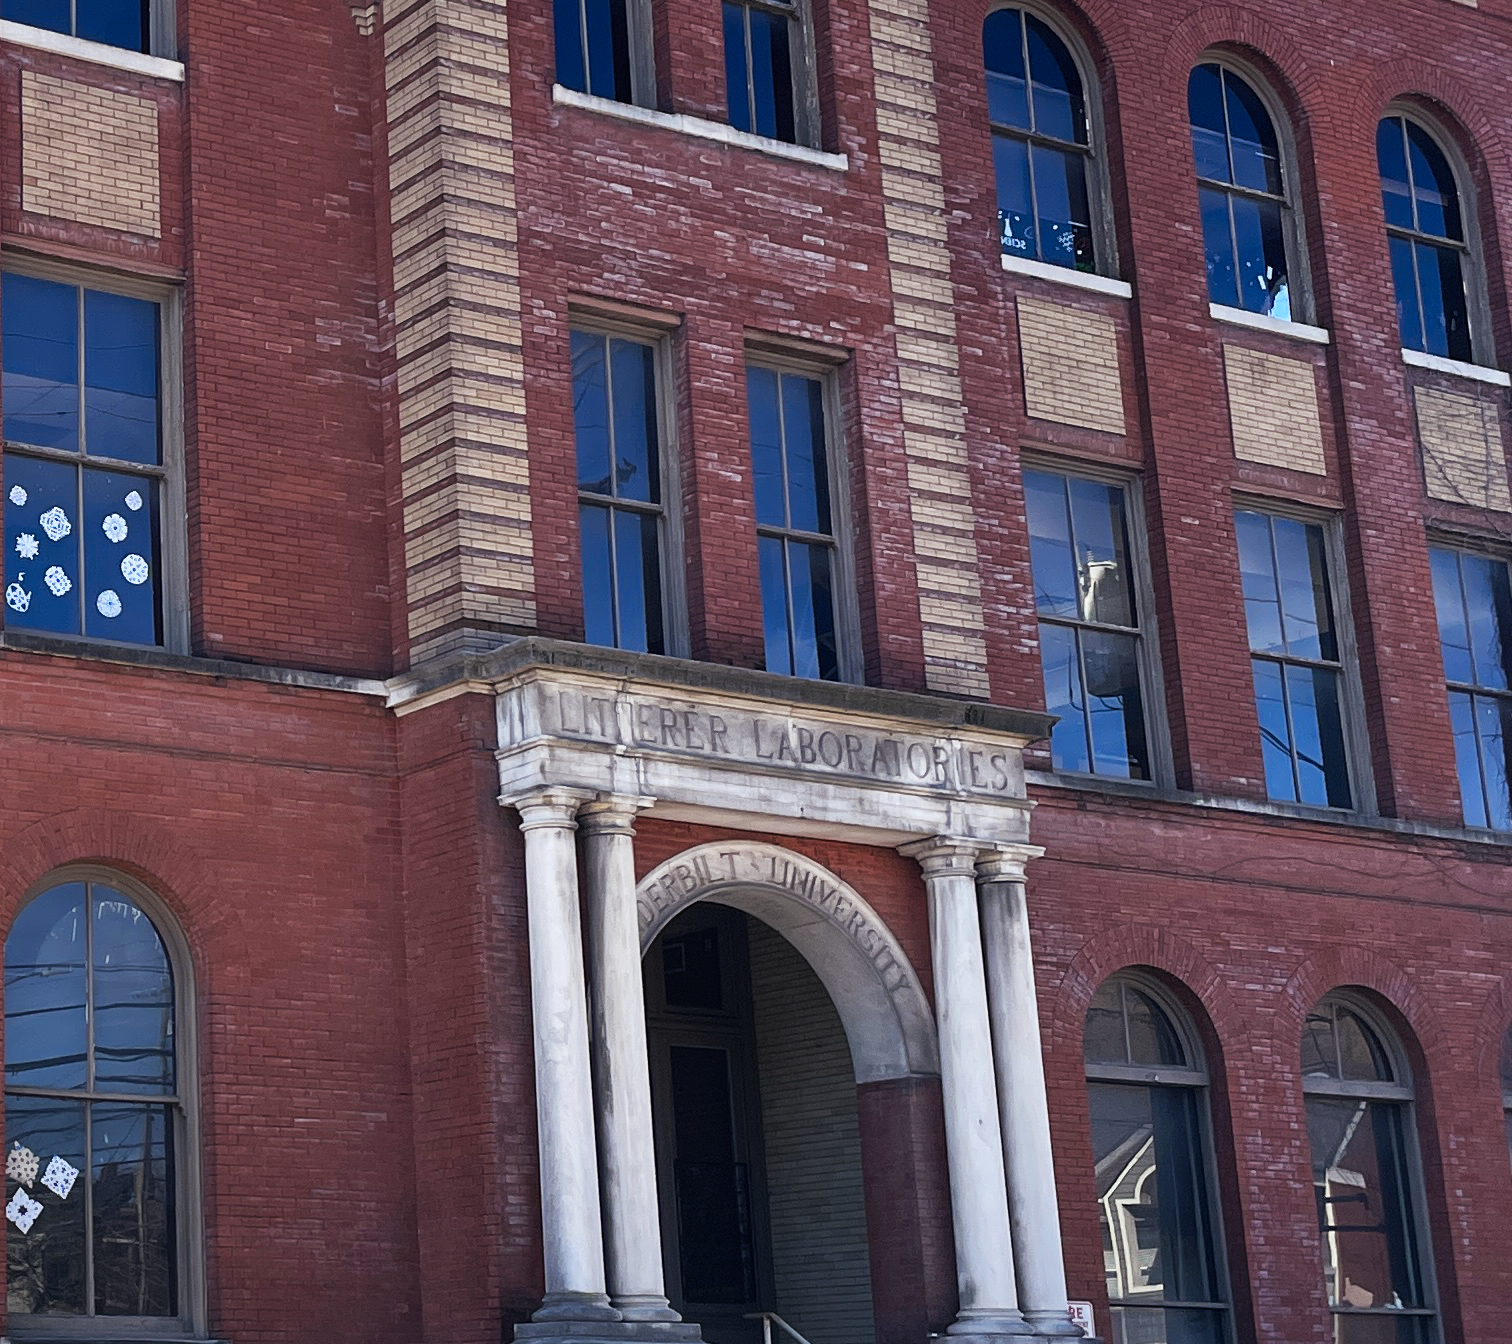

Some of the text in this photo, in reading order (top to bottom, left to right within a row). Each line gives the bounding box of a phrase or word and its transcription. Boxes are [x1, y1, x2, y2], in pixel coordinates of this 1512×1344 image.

[752, 718, 1010, 792] LABORATORIES
[636, 851, 913, 994] DERBILT UNIVERSITY
